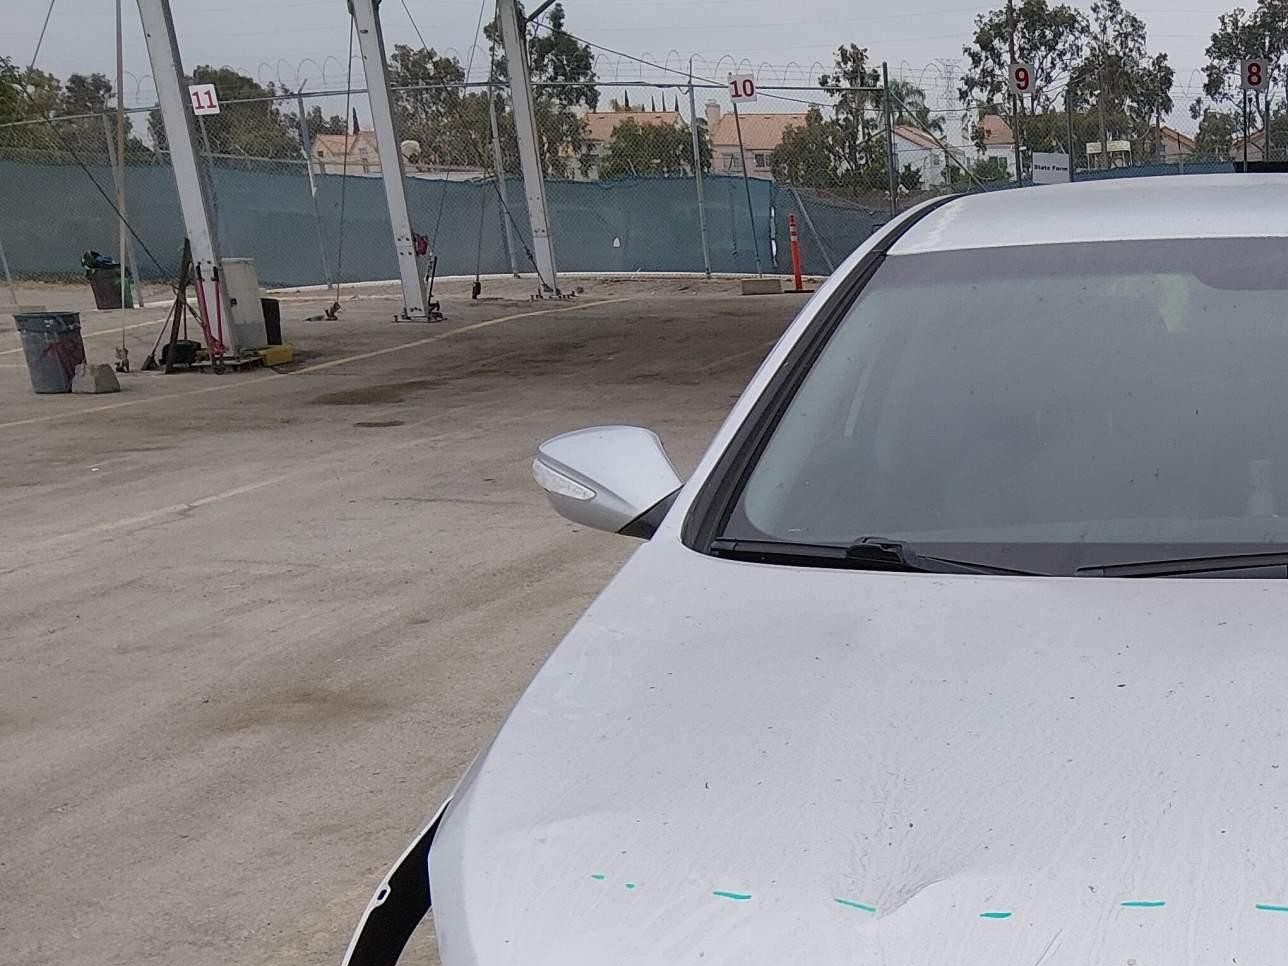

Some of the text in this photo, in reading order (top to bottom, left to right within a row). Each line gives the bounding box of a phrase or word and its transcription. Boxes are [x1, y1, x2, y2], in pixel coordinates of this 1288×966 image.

[1015, 67, 1029, 90] 9
[1247, 62, 1262, 86] 8
[730, 79, 754, 97] 10
[192, 90, 217, 109] 11
